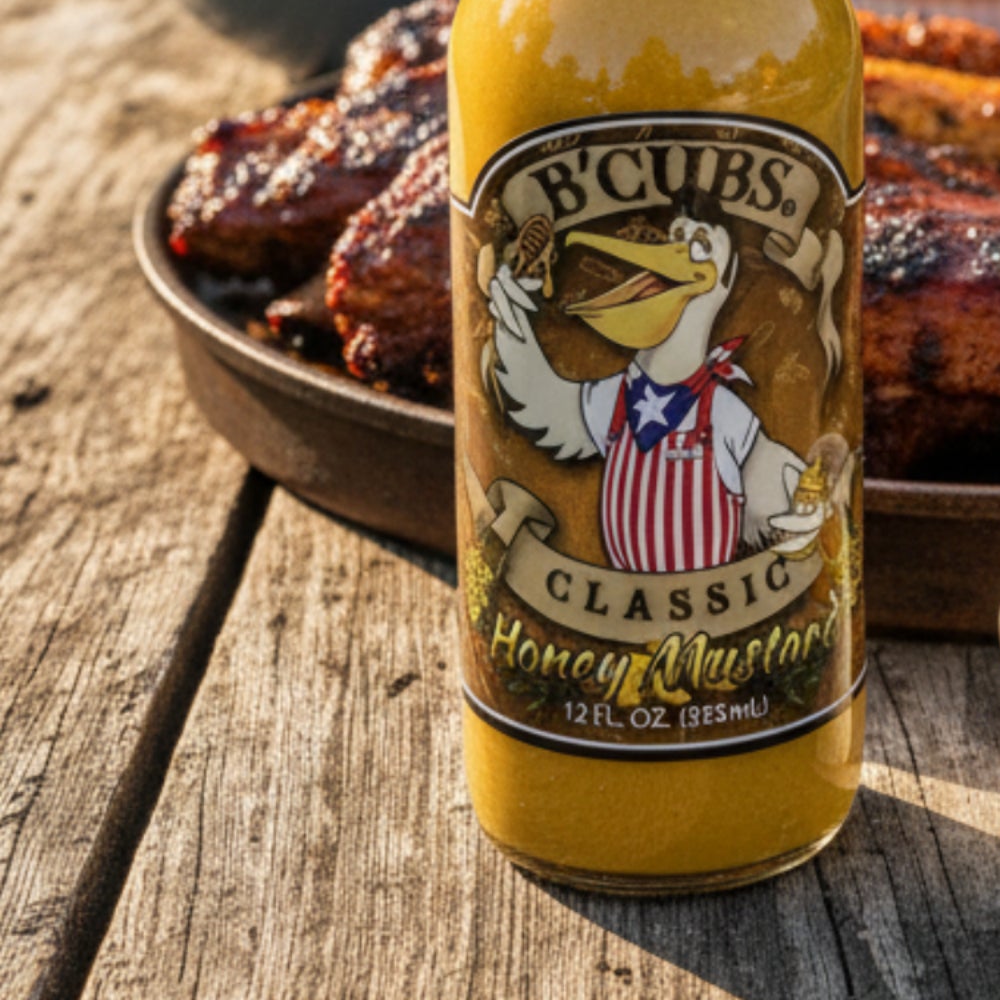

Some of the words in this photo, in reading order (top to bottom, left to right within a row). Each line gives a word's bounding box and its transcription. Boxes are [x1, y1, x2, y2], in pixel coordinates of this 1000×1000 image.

[546, 558, 792, 621] CLASSIC
[490, 611, 630, 702] Honey
[564, 701, 588, 725] 12
[629, 707, 671, 729] OZ
